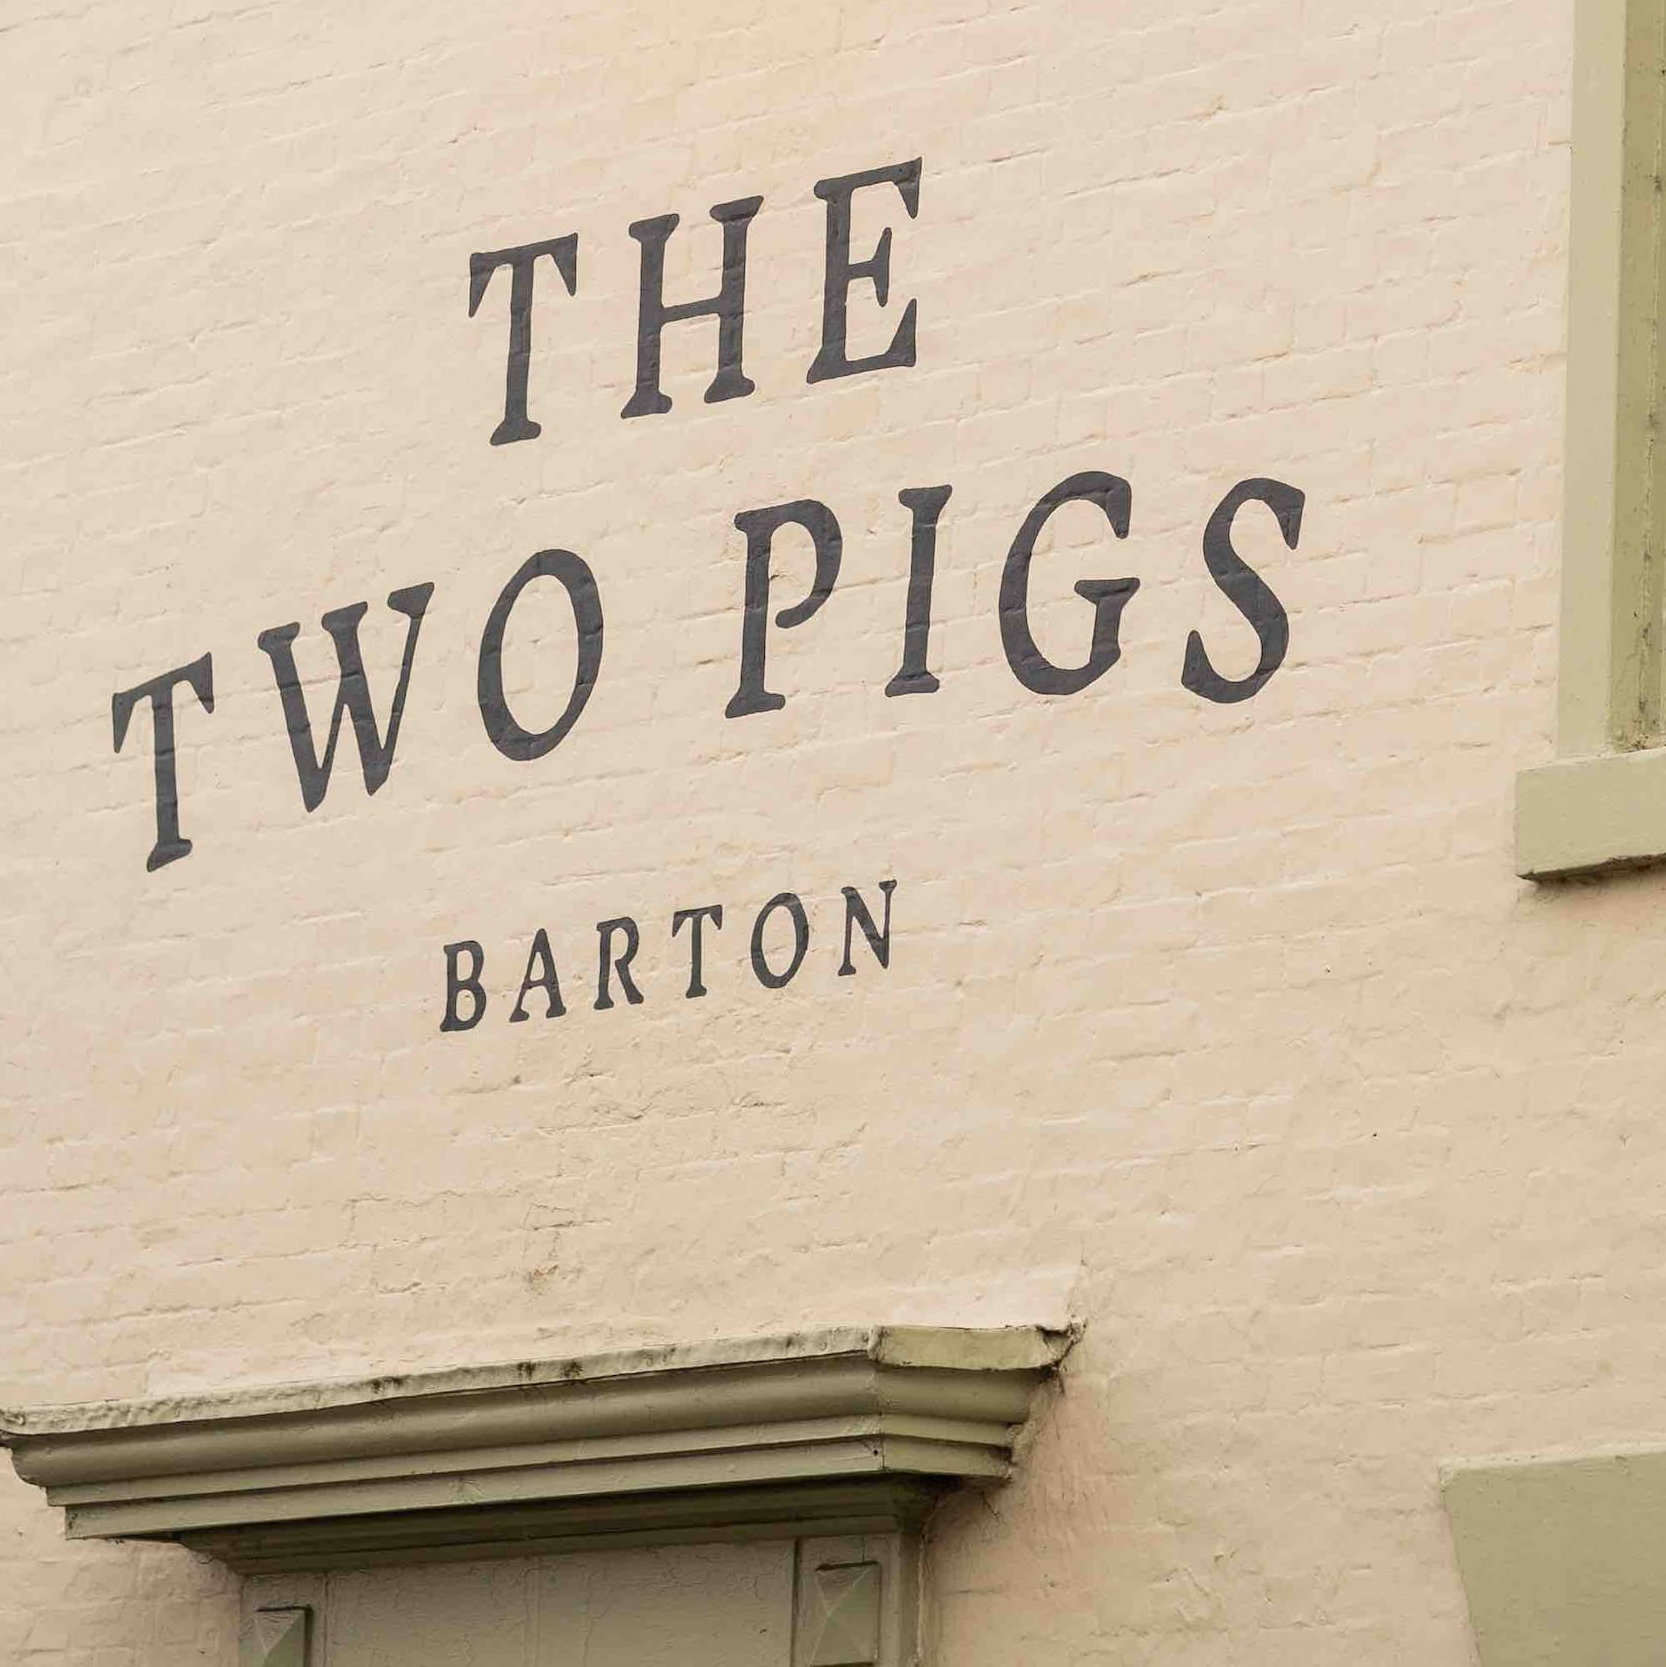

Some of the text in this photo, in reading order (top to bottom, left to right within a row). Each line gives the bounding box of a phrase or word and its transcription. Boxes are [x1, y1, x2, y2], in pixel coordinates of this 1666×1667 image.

[468, 156, 923, 447] THE
[111, 470, 1306, 873] TWO PIGS
[439, 878, 898, 1033] BARTON
